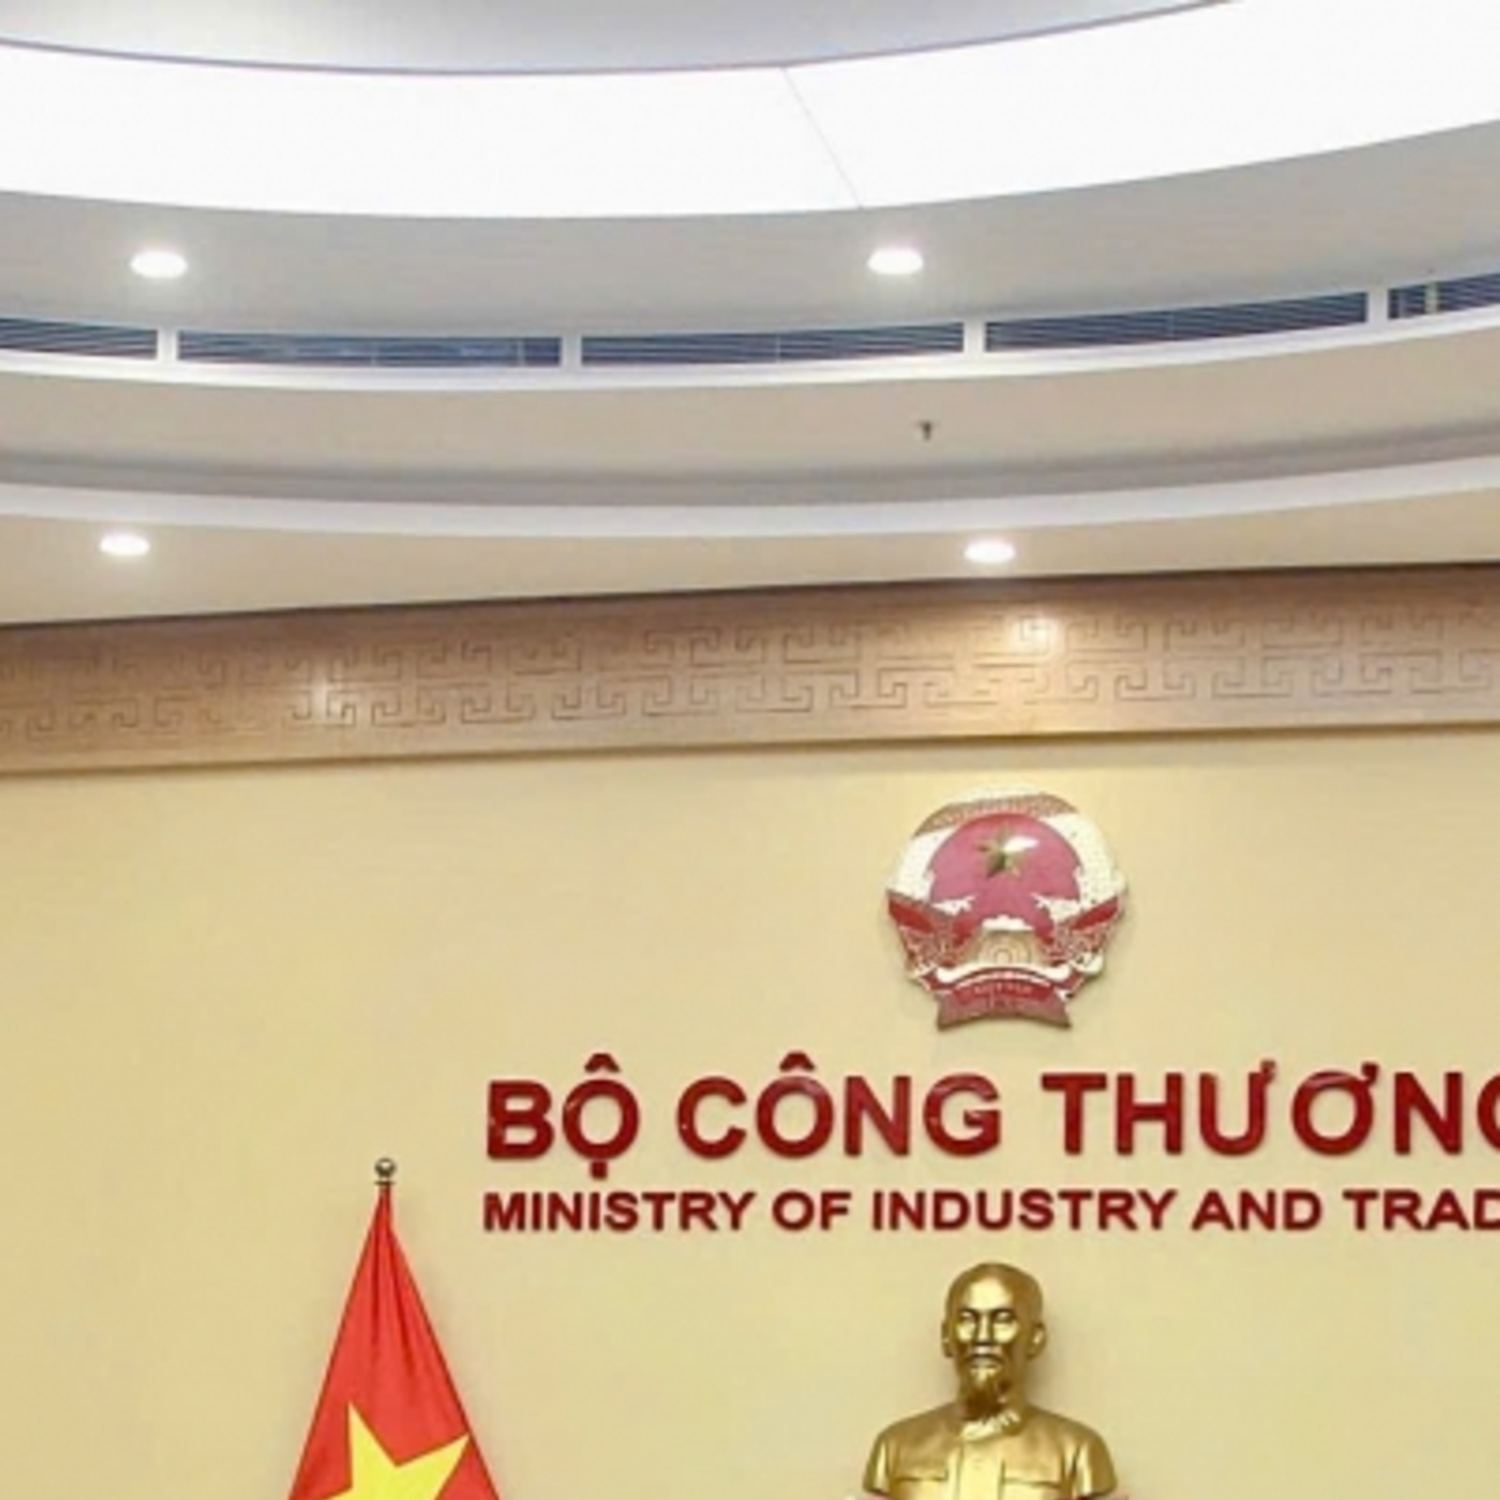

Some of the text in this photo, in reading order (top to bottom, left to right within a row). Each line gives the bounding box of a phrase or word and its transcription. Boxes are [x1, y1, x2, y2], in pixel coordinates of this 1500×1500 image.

[487, 1053, 640, 1181] BỘ
[677, 1051, 1001, 1160] CÔNG
[483, 1190, 758, 1232] MINISTRY
[772, 1190, 853, 1232] OF
[872, 1189, 1178, 1232] INDUSTRY
[1191, 1188, 1323, 1231] AND
